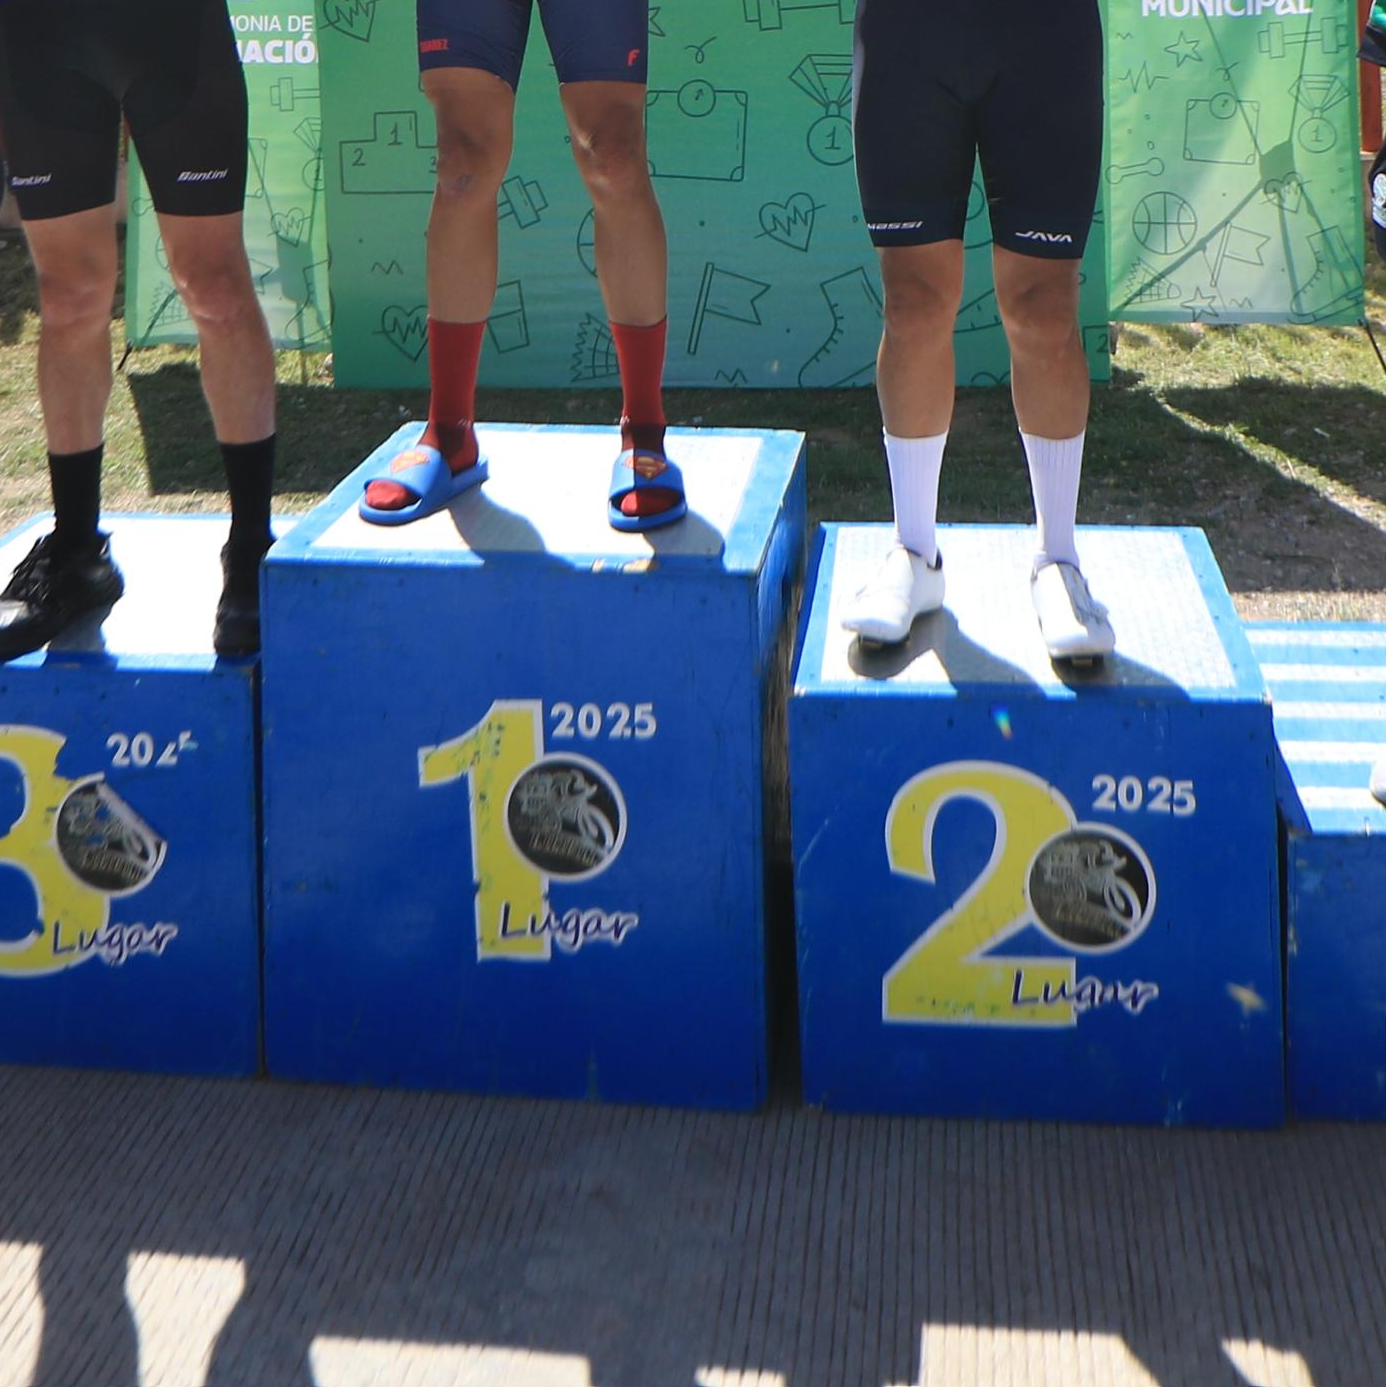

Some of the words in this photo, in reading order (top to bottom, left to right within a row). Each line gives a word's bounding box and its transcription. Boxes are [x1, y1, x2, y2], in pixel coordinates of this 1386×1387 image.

[287, 15, 313, 32] DE
[177, 168, 229, 182] Santini
[1015, 230, 1072, 243] JAVA
[550, 701, 658, 740] 2025
[1091, 774, 1196, 816] 2025
[417, 699, 551, 962] 1
[882, 760, 1078, 1027] 2
[53, 919, 179, 966] Lugar
[500, 900, 639, 952] Lugar
